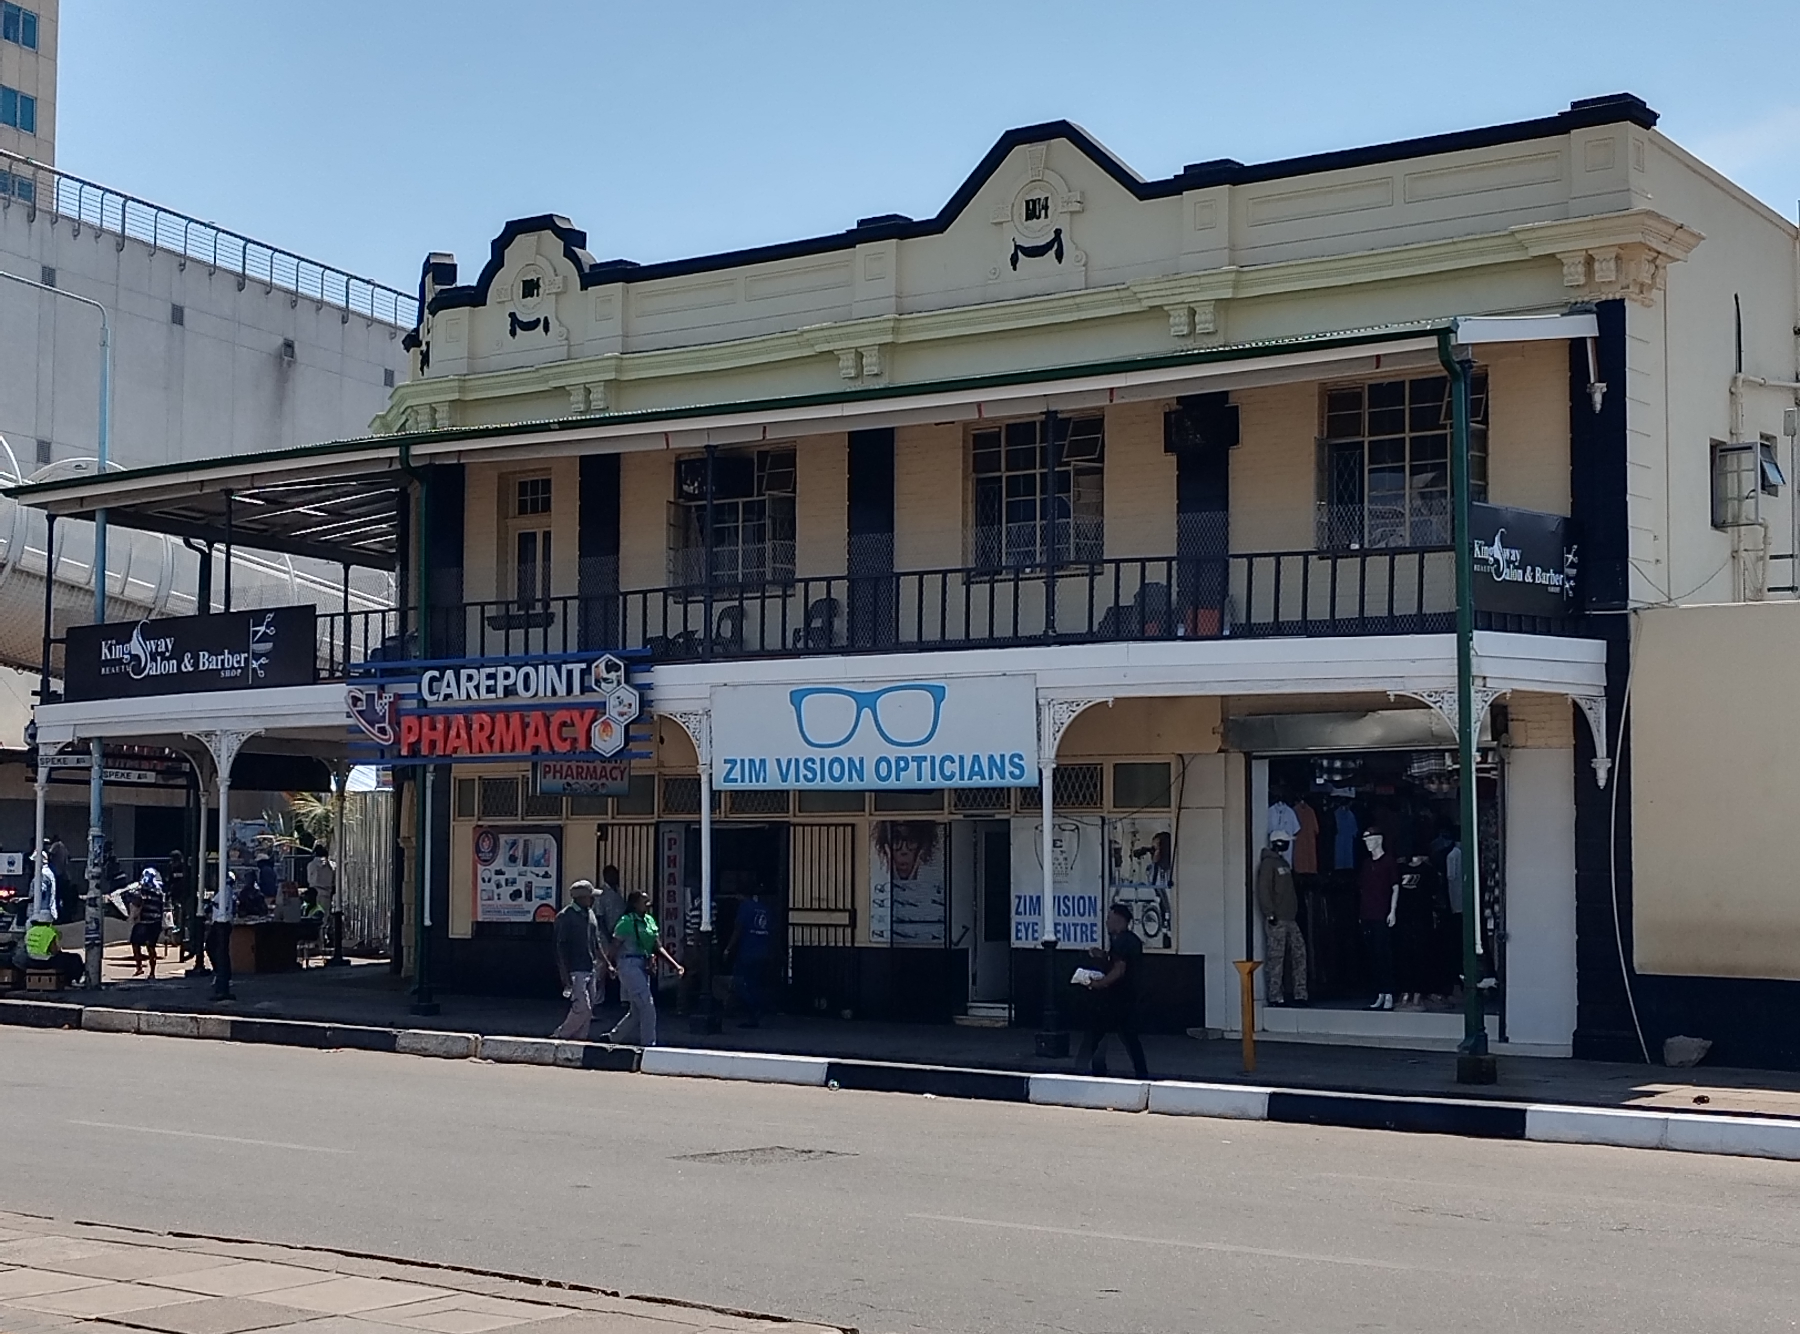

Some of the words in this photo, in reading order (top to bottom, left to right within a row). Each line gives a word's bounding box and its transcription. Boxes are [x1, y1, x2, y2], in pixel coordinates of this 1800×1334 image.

[1524, 565, 1534, 583] &
[1534, 566, 1564, 586] Barber
[181, 653, 194, 673] &
[198, 649, 248, 671] Barber
[420, 663, 587, 702] CAREPOINT
[400, 708, 597, 757] PHARMACY
[542, 763, 628, 782] PHARMACY
[722, 758, 767, 784] ZIM
[775, 756, 865, 784] VISION
[873, 752, 1026, 782] OPTICIANS
[665, 837, 679, 973] PHARMAC
[1014, 895, 1042, 917] ZIM
[1053, 895, 1098, 918] ISION
[1014, 921, 1040, 942] EYE
[1055, 922, 1098, 943] ENTRE
